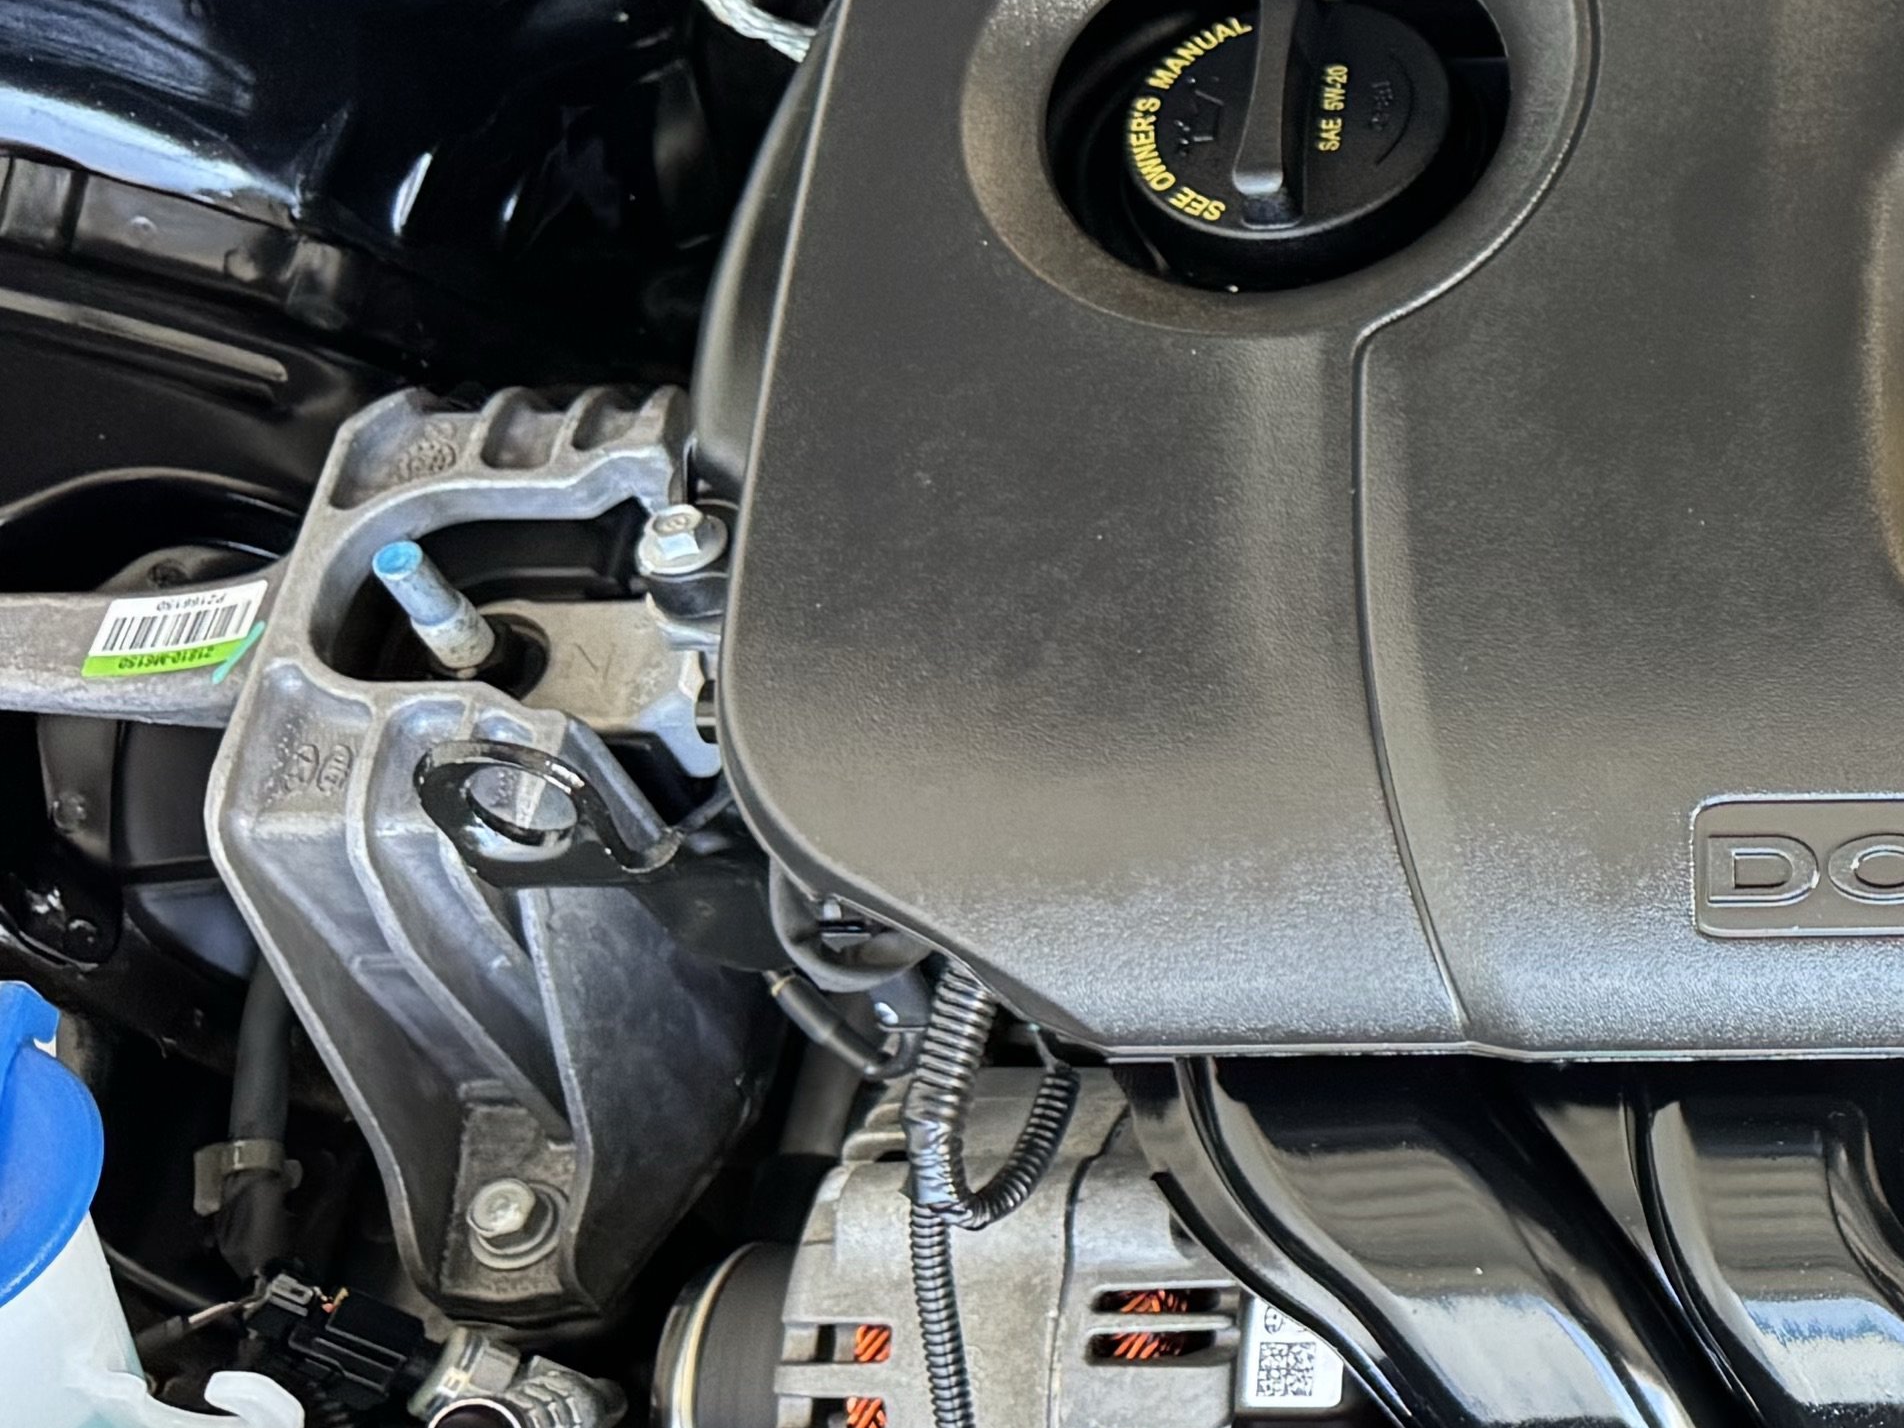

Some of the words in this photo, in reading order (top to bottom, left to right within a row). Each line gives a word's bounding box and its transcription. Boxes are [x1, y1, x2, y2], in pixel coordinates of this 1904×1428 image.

[1146, 16, 1253, 90] MANUAL
[1323, 65, 1348, 110] 5W-20
[1130, 97, 1176, 192] OWNER'S
[1318, 117, 1342, 151] SAE
[1168, 187, 1226, 221] SEE
